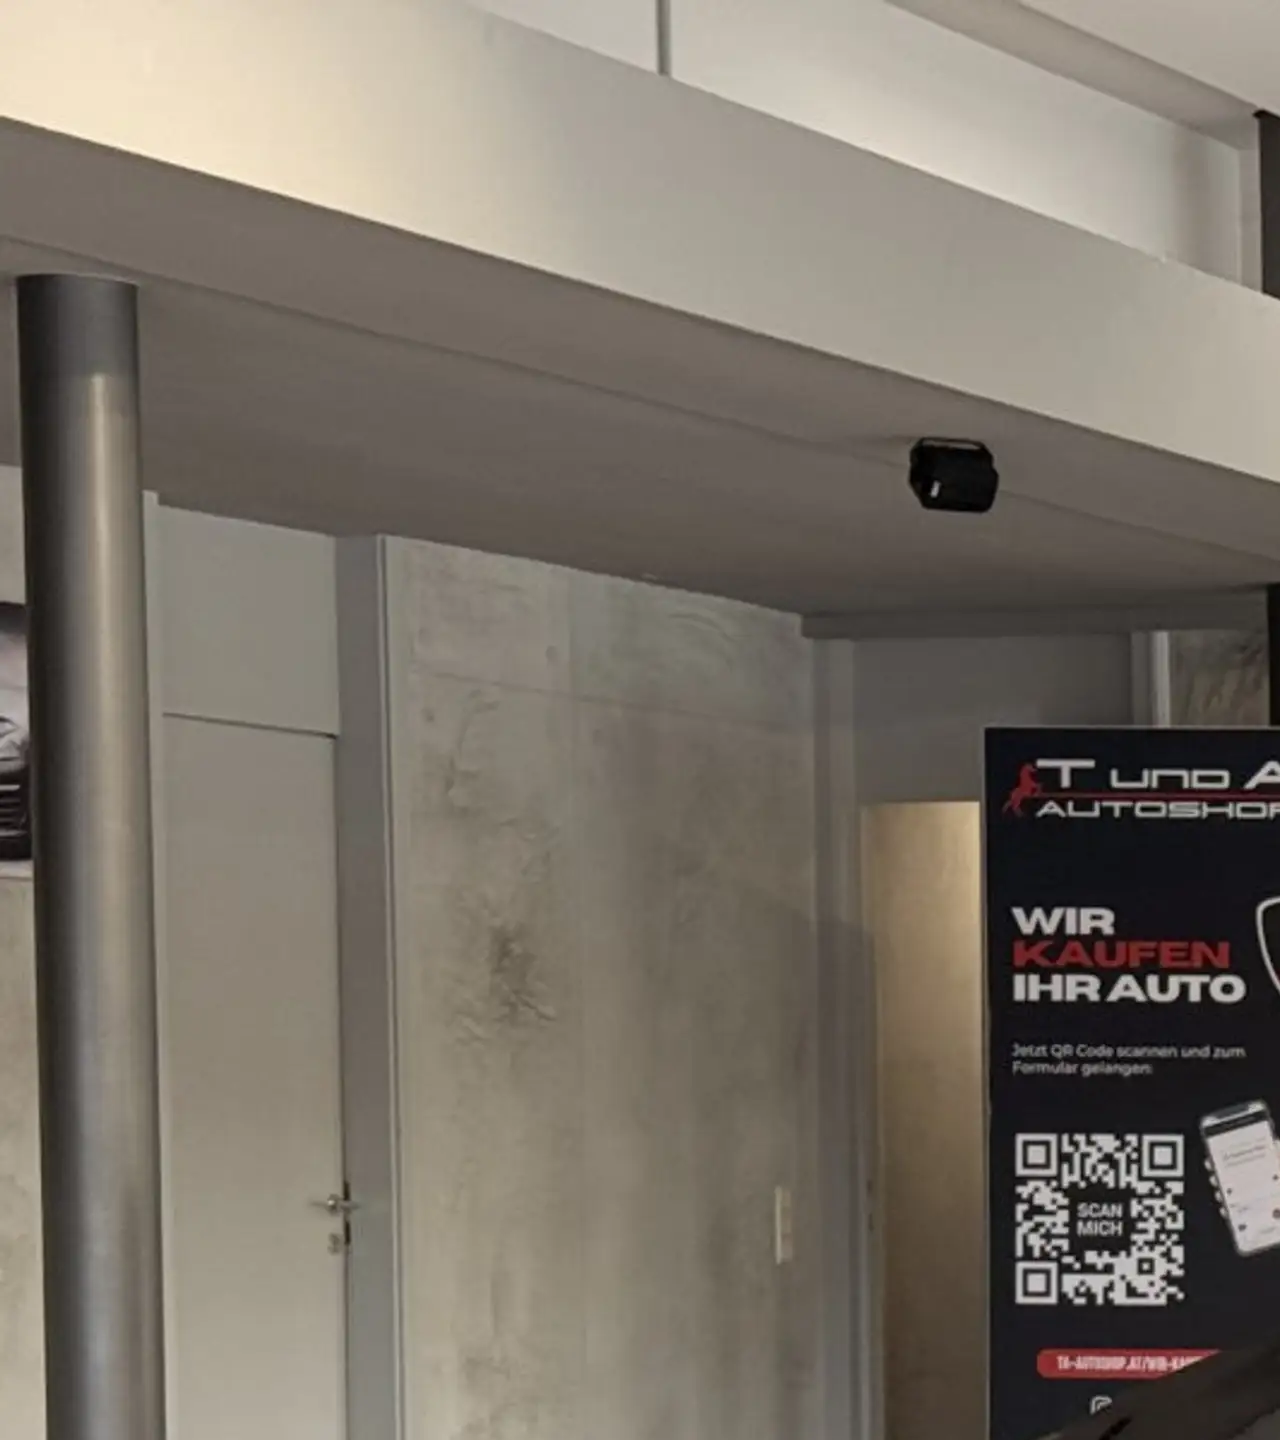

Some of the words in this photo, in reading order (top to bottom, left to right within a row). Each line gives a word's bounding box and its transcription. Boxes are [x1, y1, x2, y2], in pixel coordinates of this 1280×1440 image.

[1036, 759, 1096, 788] T
[1011, 907, 1115, 935] WIR
[1012, 941, 1230, 968] KAUFEN
[1013, 974, 1101, 1002] IHR
[1106, 974, 1247, 1003] AUTO
[1012, 1042, 1048, 1057] Jetzt
[1050, 1044, 1074, 1059] QR
[1076, 1043, 1114, 1057] Code
[1116, 1046, 1178, 1057] scannen
[1181, 1044, 1211, 1057] und
[1213, 1046, 1247, 1057] zum
[1012, 1061, 1078, 1075] Formular
[1077, 1202, 1123, 1218] SCAN
[1077, 1220, 1123, 1236] MICH
